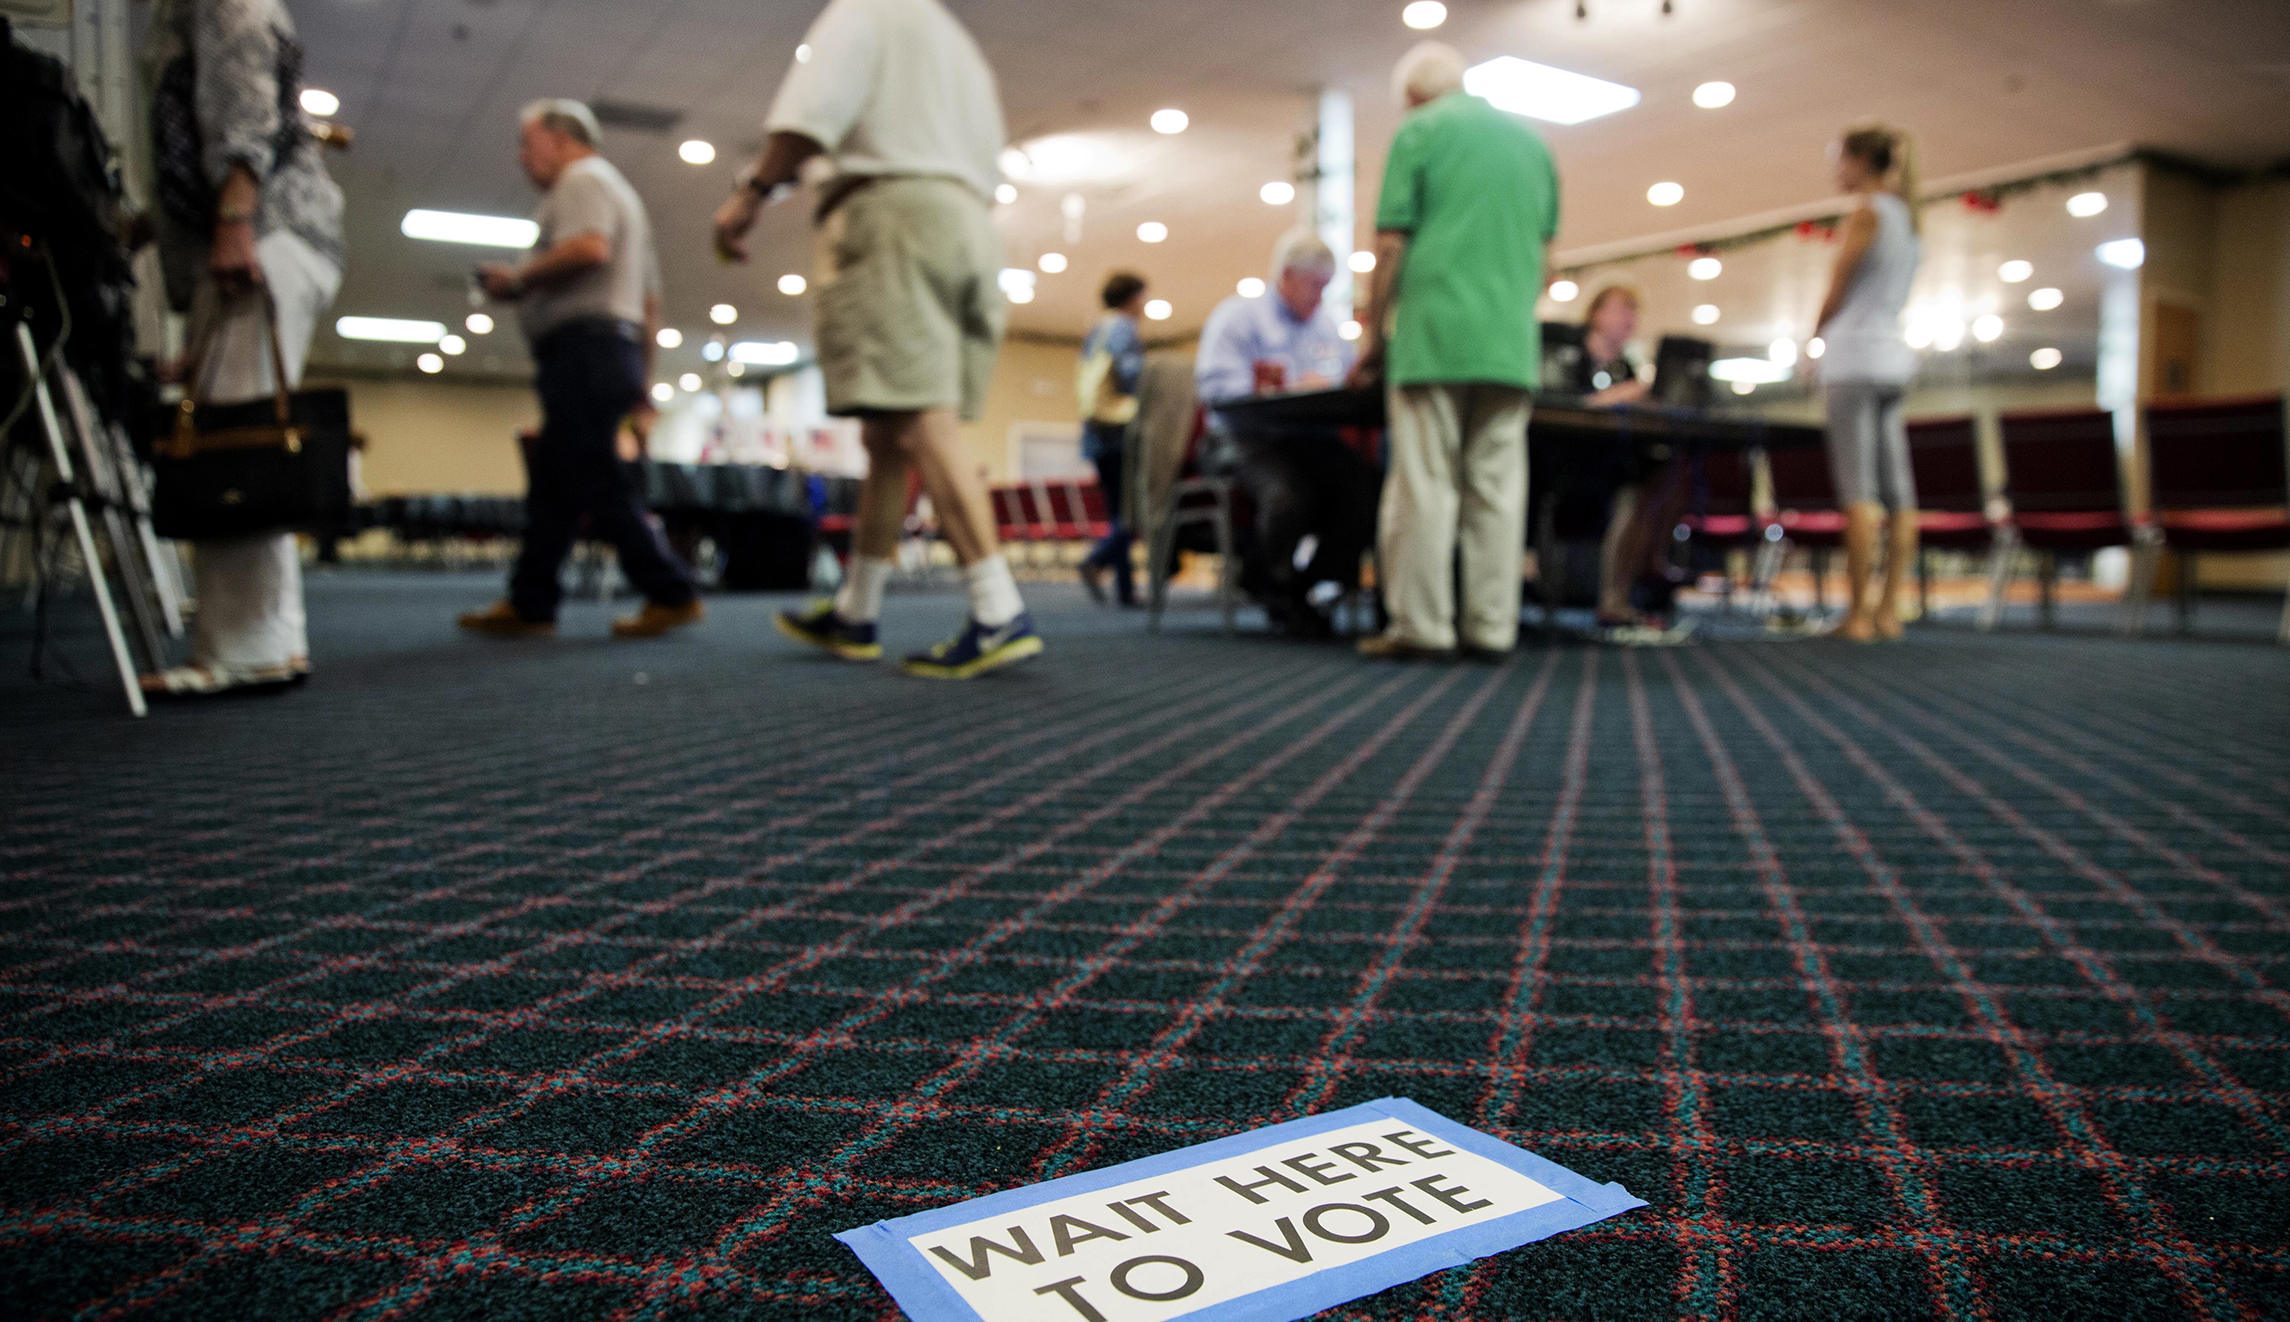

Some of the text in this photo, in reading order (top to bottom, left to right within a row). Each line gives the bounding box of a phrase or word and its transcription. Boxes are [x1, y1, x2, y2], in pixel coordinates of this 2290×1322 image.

[929, 1130, 1457, 1281] WAIT HERE
[1032, 1173, 1494, 1322] TO VOTE
